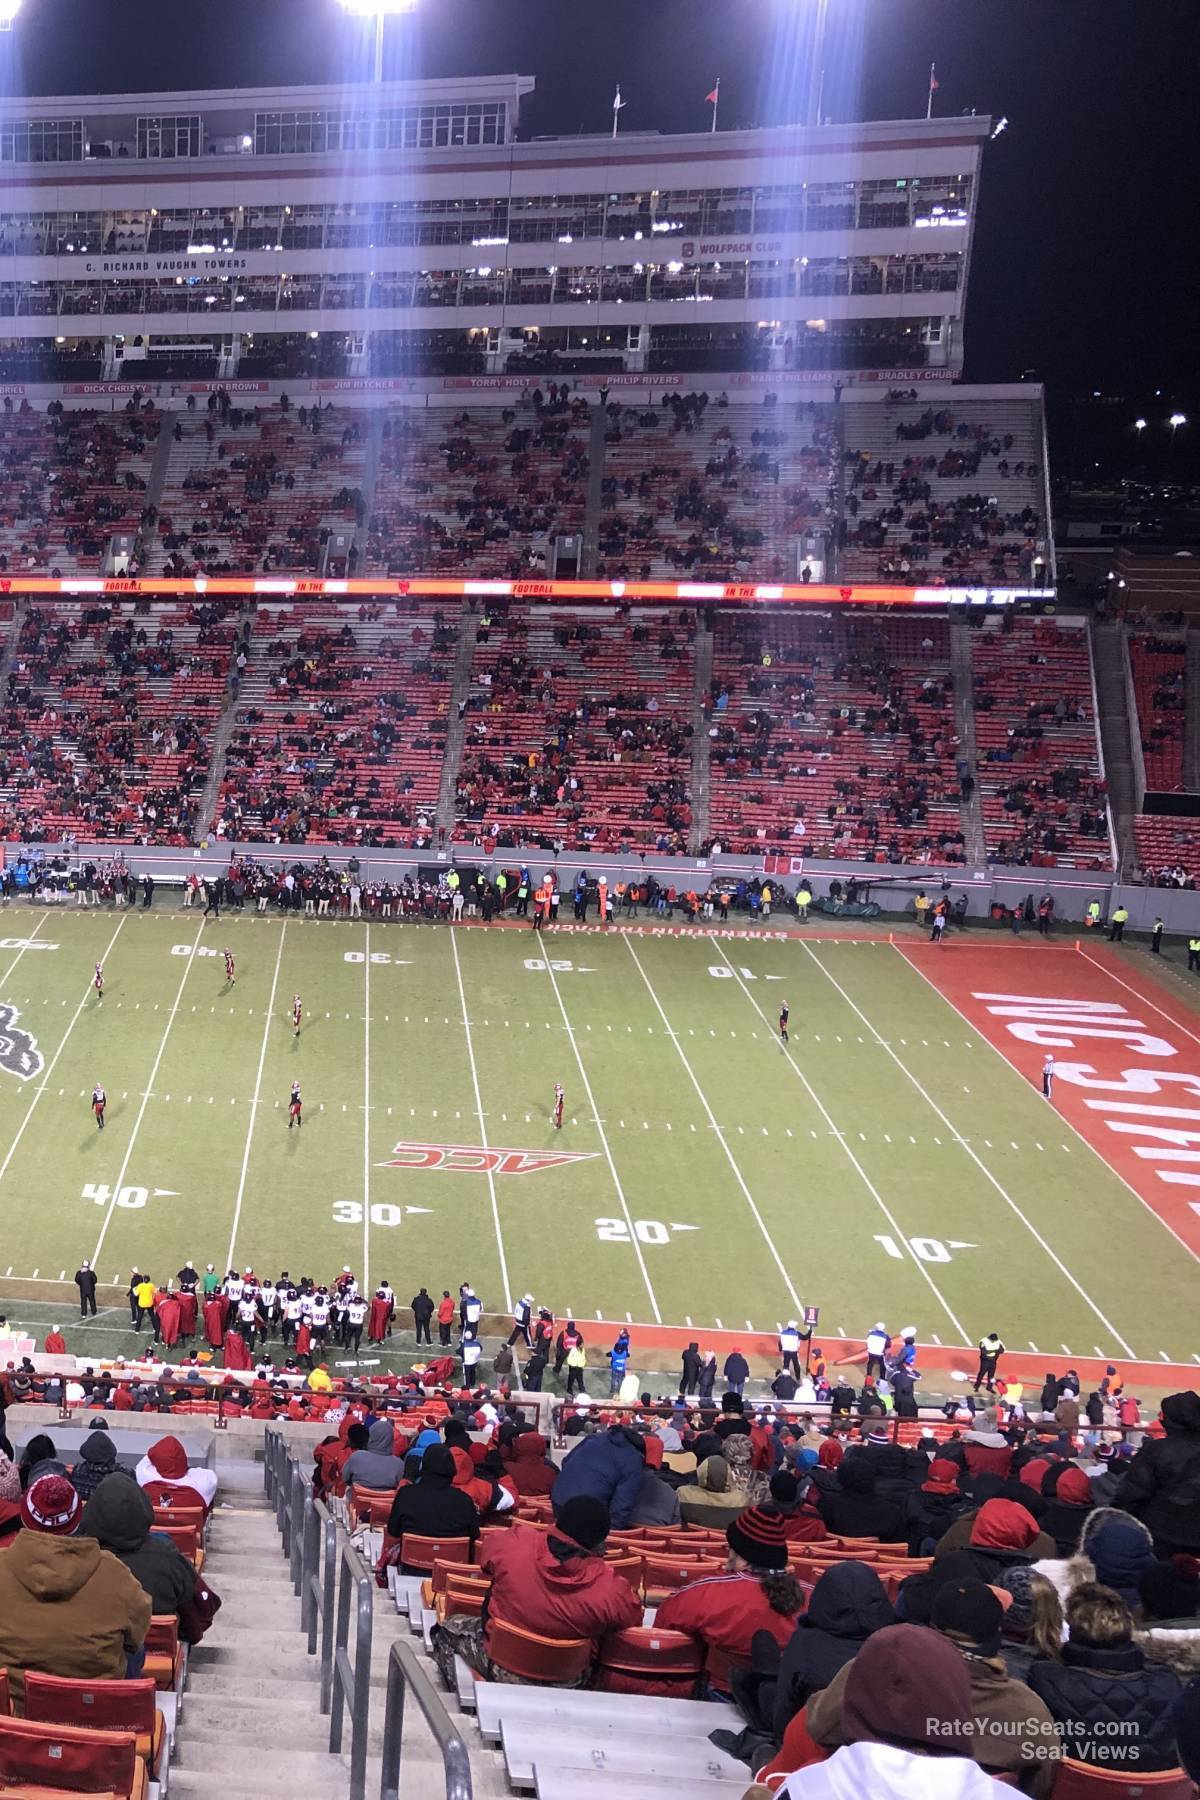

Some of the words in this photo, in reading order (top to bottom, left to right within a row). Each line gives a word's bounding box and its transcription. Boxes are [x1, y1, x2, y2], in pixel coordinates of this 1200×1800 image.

[700, 244, 752, 254] WOLFPACK
[756, 242, 782, 252] CLUB
[86, 263, 96, 271] C.
[103, 261, 149, 271] RICHARD
[156, 260, 197, 270] VAUGHN
[204, 259, 247, 268] TOWERS
[606, 376, 640, 384] PHILIP
[642, 375, 680, 384] RIVERS
[785, 373, 833, 382] WILLIAMS
[878, 370, 922, 380] BRADLEY
[924, 369, 960, 379] CHUBB
[226, 383, 259, 391] BROWN
[334, 381, 351, 389] JIM
[354, 380, 395, 388] RITCHER
[470, 378, 501, 387] TORRY
[505, 378, 531, 386] HOLT
[84, 385, 106, 393] DICK
[108, 384, 147, 393] CHRISTY
[105, 582, 142, 591] FOOTBALL
[297, 583, 307, 591] IN
[309, 583, 323, 591] THE
[512, 584, 553, 593] FOOTBALL
[726, 588, 736, 596] IN
[739, 588, 755, 597] THE
[679, 927, 788, 938] STRENGTH
[171, 944, 217, 957] 40
[344, 952, 391, 964] 30
[523, 958, 573, 971] 20
[708, 966, 757, 979] 10
[970, 992, 1179, 1056] NC
[373, 1142, 602, 1174] ACC
[81, 1183, 149, 1209] 40
[332, 1200, 401, 1227] 30
[595, 1217, 671, 1244] 20
[872, 1234, 952, 1264] 10
